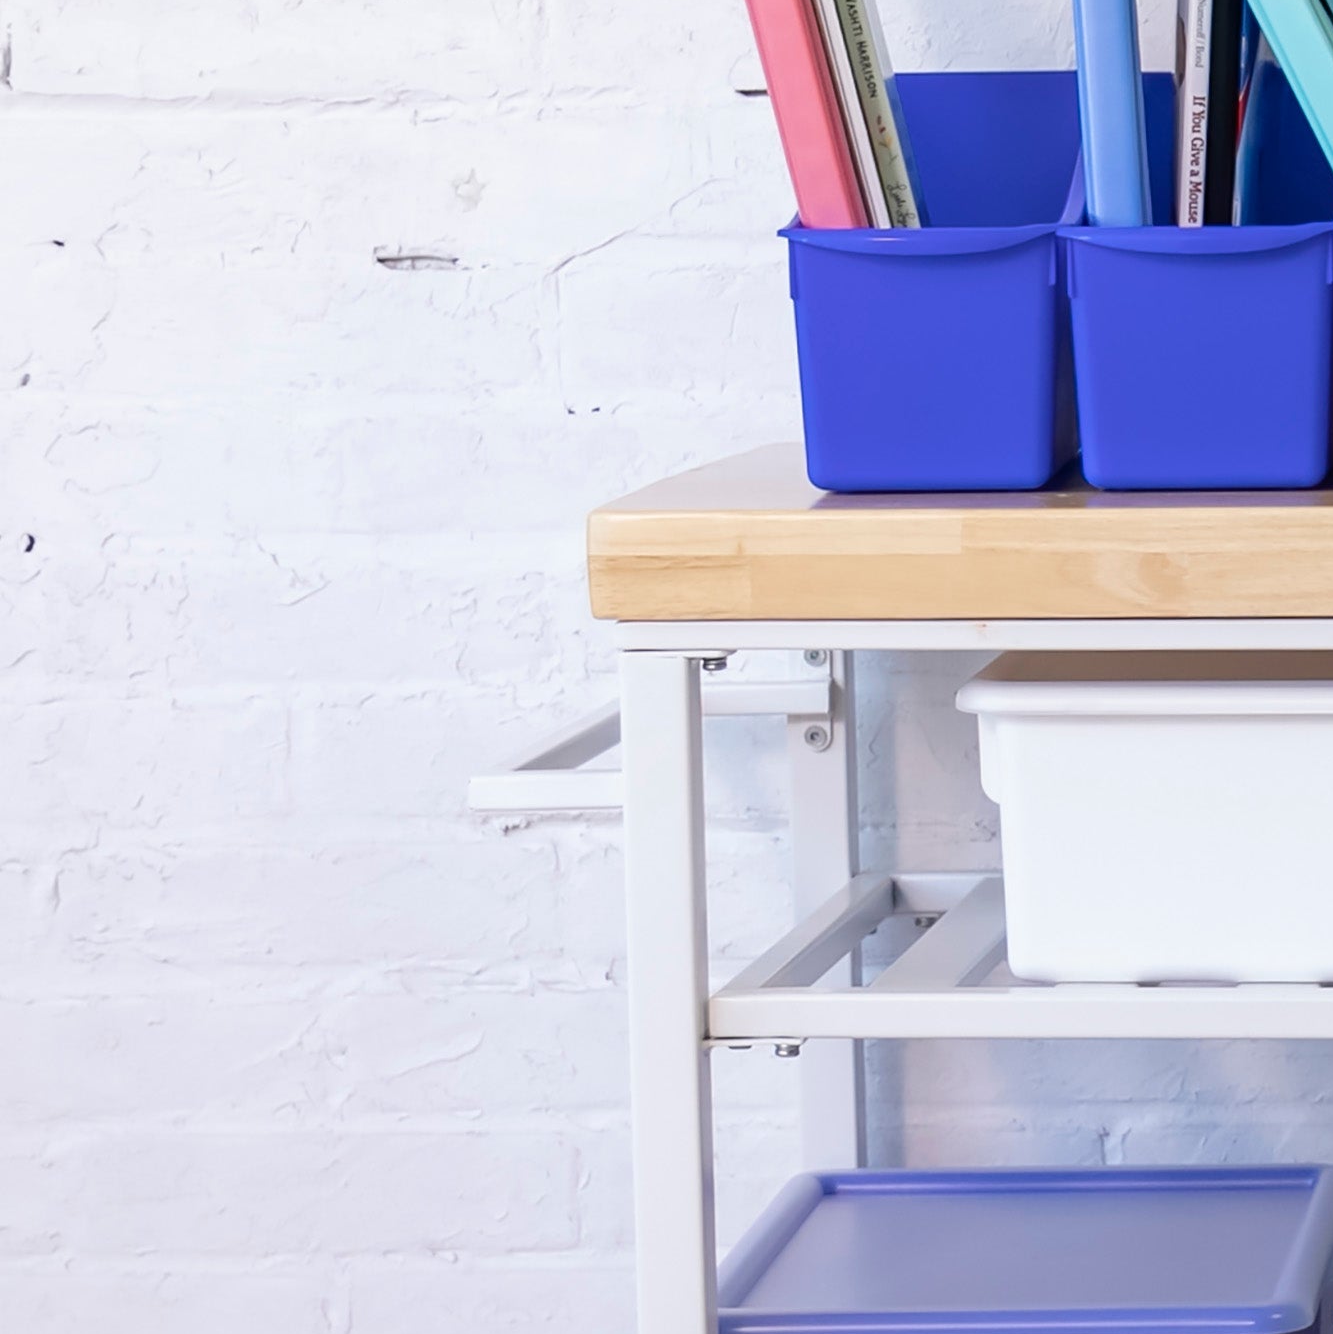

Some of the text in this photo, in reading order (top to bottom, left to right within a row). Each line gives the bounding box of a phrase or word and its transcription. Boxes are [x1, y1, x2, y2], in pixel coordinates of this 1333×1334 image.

[856, 40, 878, 99] HARRISON
[1188, 96, 1206, 223] If You Give a Mouse
